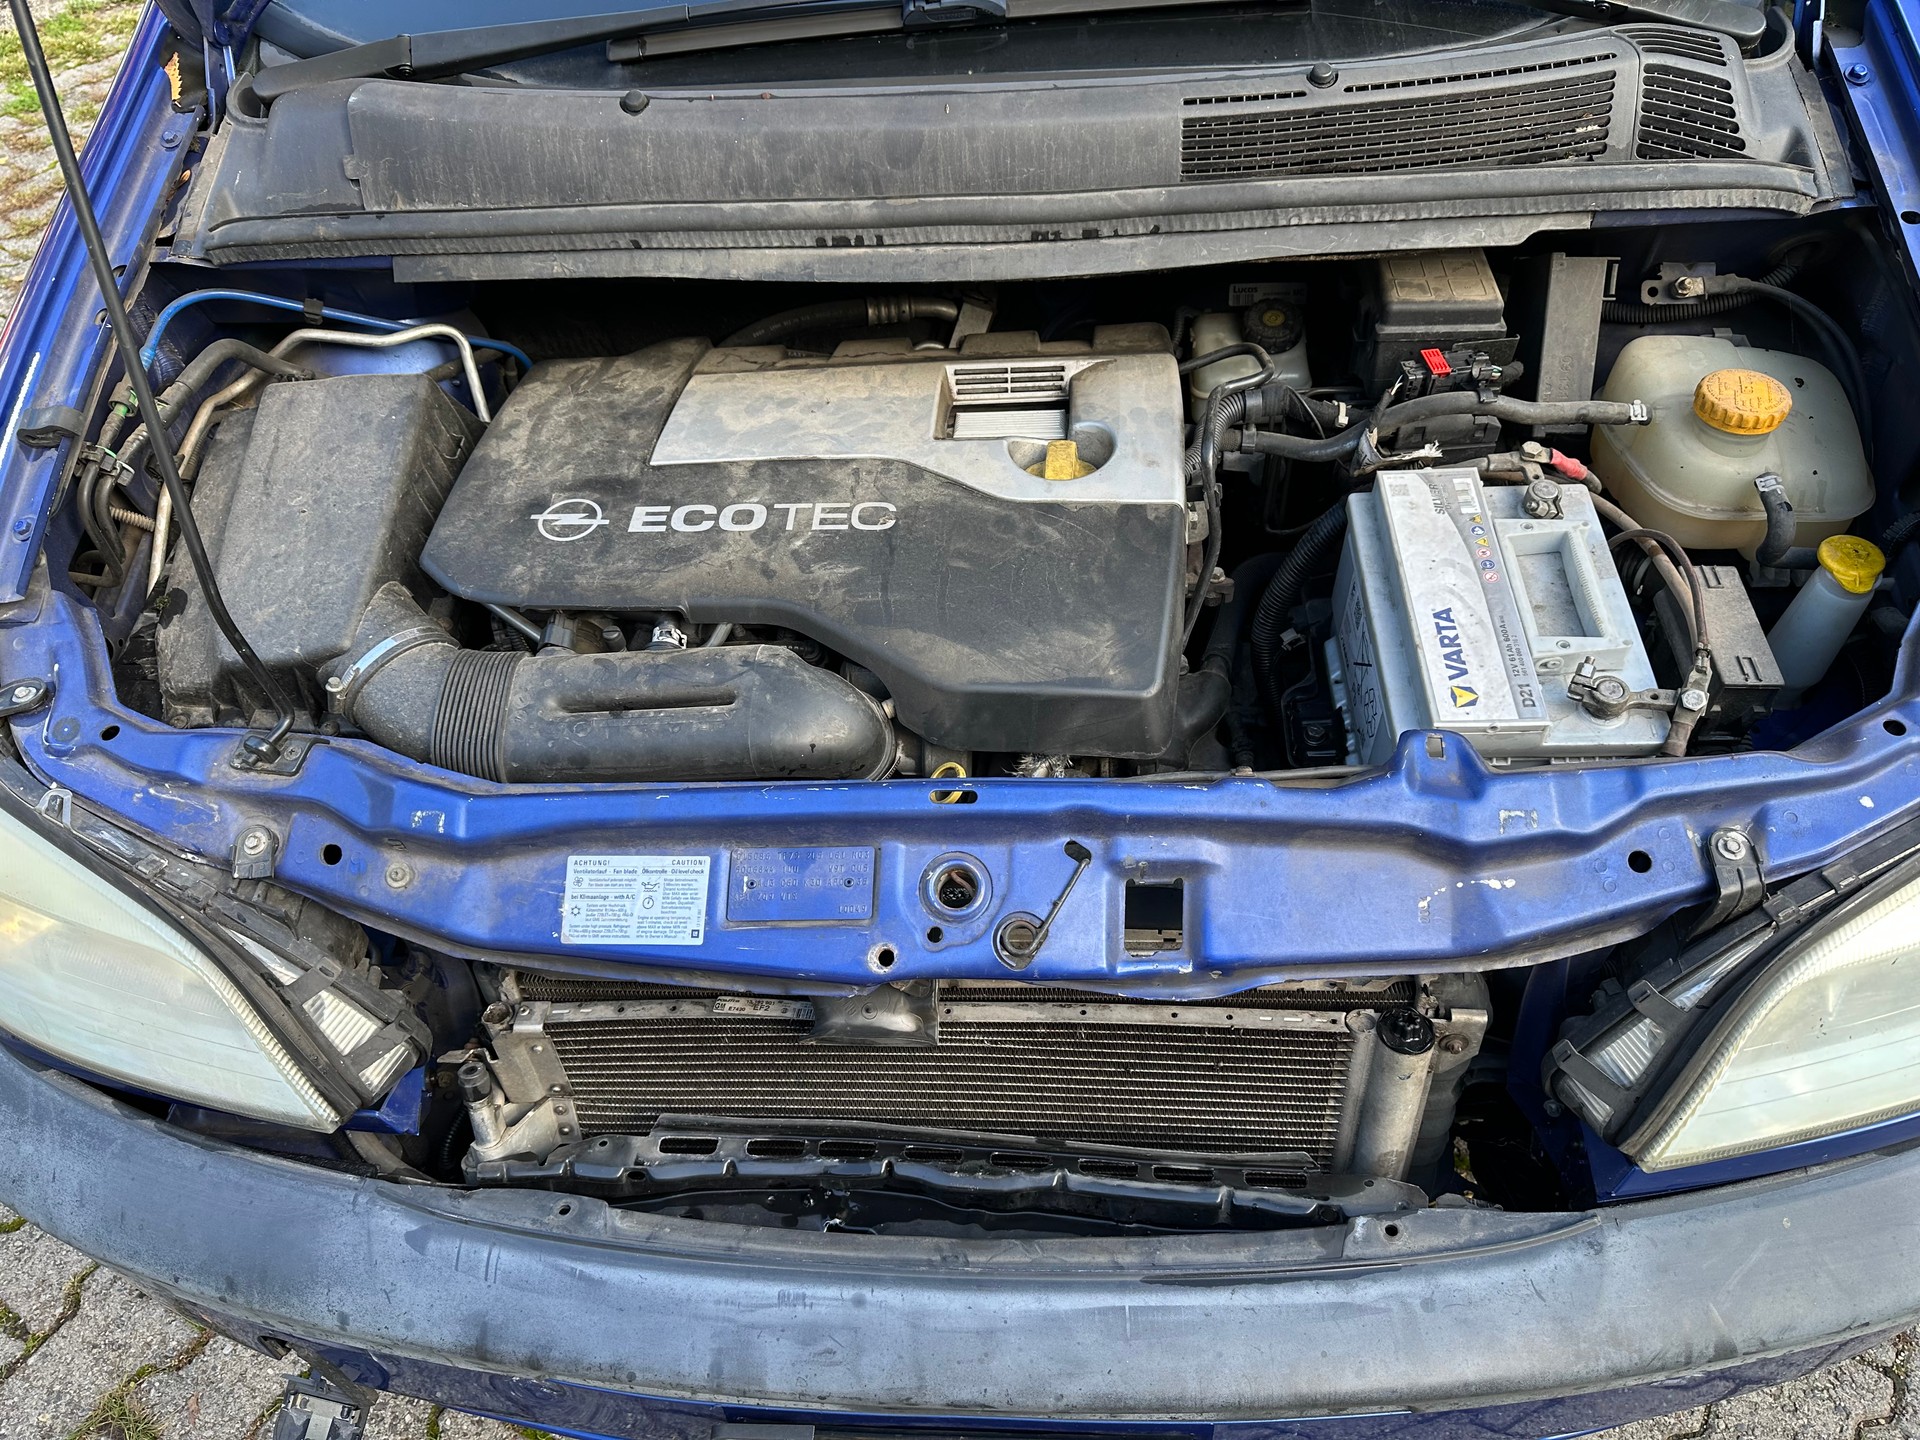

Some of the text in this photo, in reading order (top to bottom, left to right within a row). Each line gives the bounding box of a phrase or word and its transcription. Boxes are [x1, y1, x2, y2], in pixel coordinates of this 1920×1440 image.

[1428, 483, 1446, 515] SILVER
[628, 501, 898, 533] ECOTEC
[1499, 623, 1511, 642] 600A
[1433, 607, 1469, 681] VARTA
[1505, 643, 1517, 662] 61Ah
[1510, 663, 1521, 677] 12V
[1517, 683, 1537, 708] D21
[752, 1004, 770, 1012] EF2
